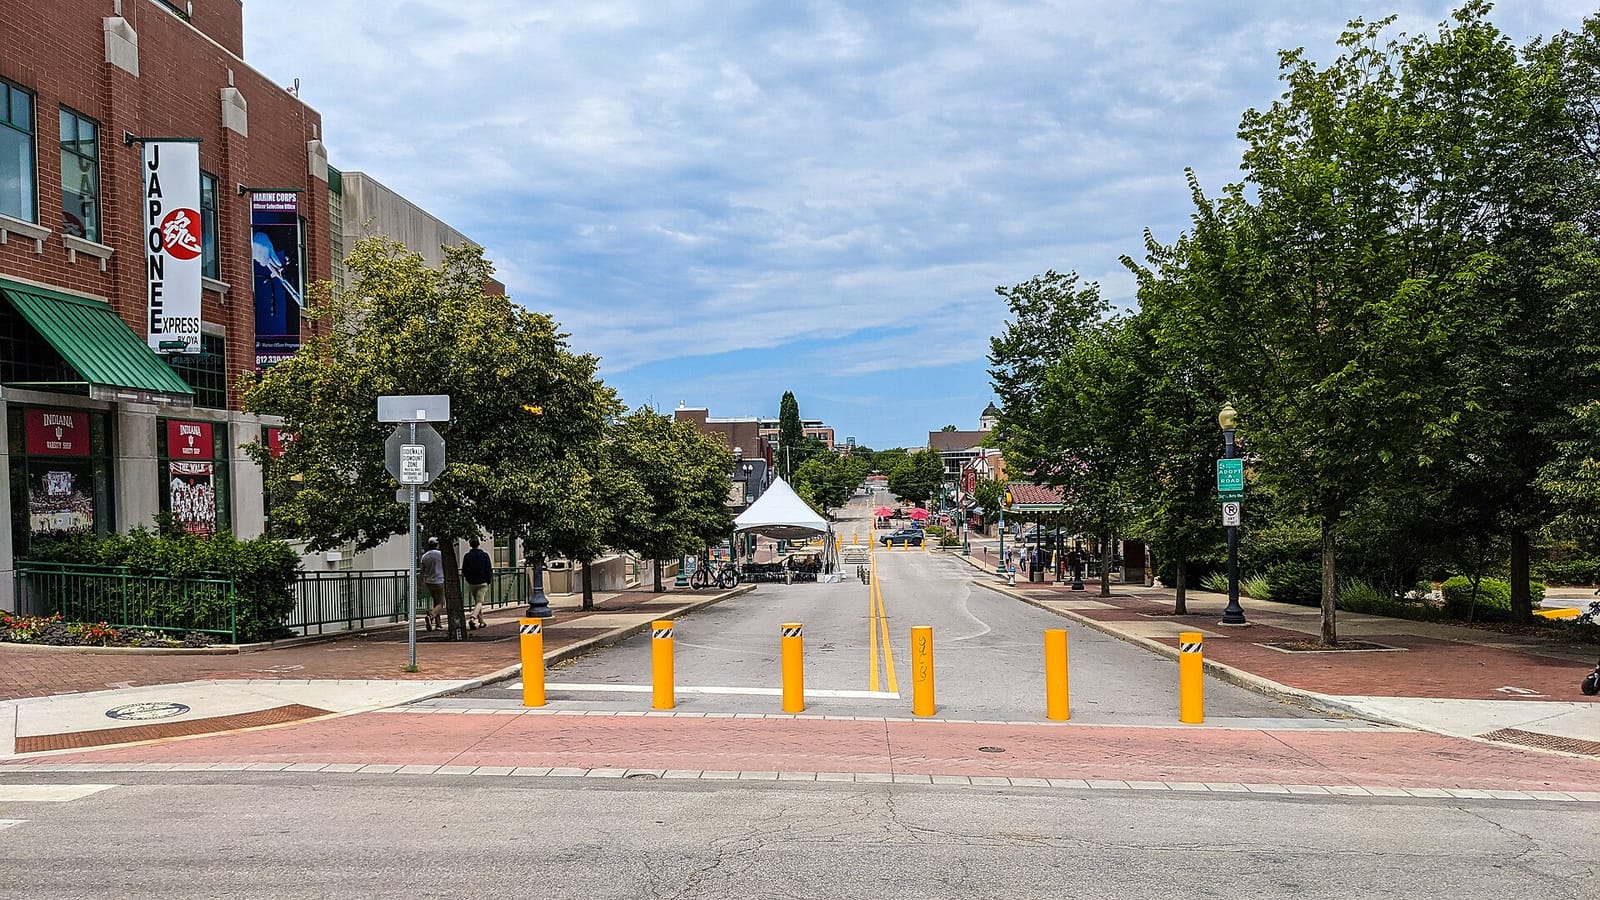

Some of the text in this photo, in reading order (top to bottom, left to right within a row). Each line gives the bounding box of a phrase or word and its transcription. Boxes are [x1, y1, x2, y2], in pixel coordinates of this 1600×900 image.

[253, 193, 297, 202] MARINE CORPS
[187, 336, 198, 344] OYA
[43, 413, 74, 428] INDIANA
[180, 424, 202, 437] INDIANA
